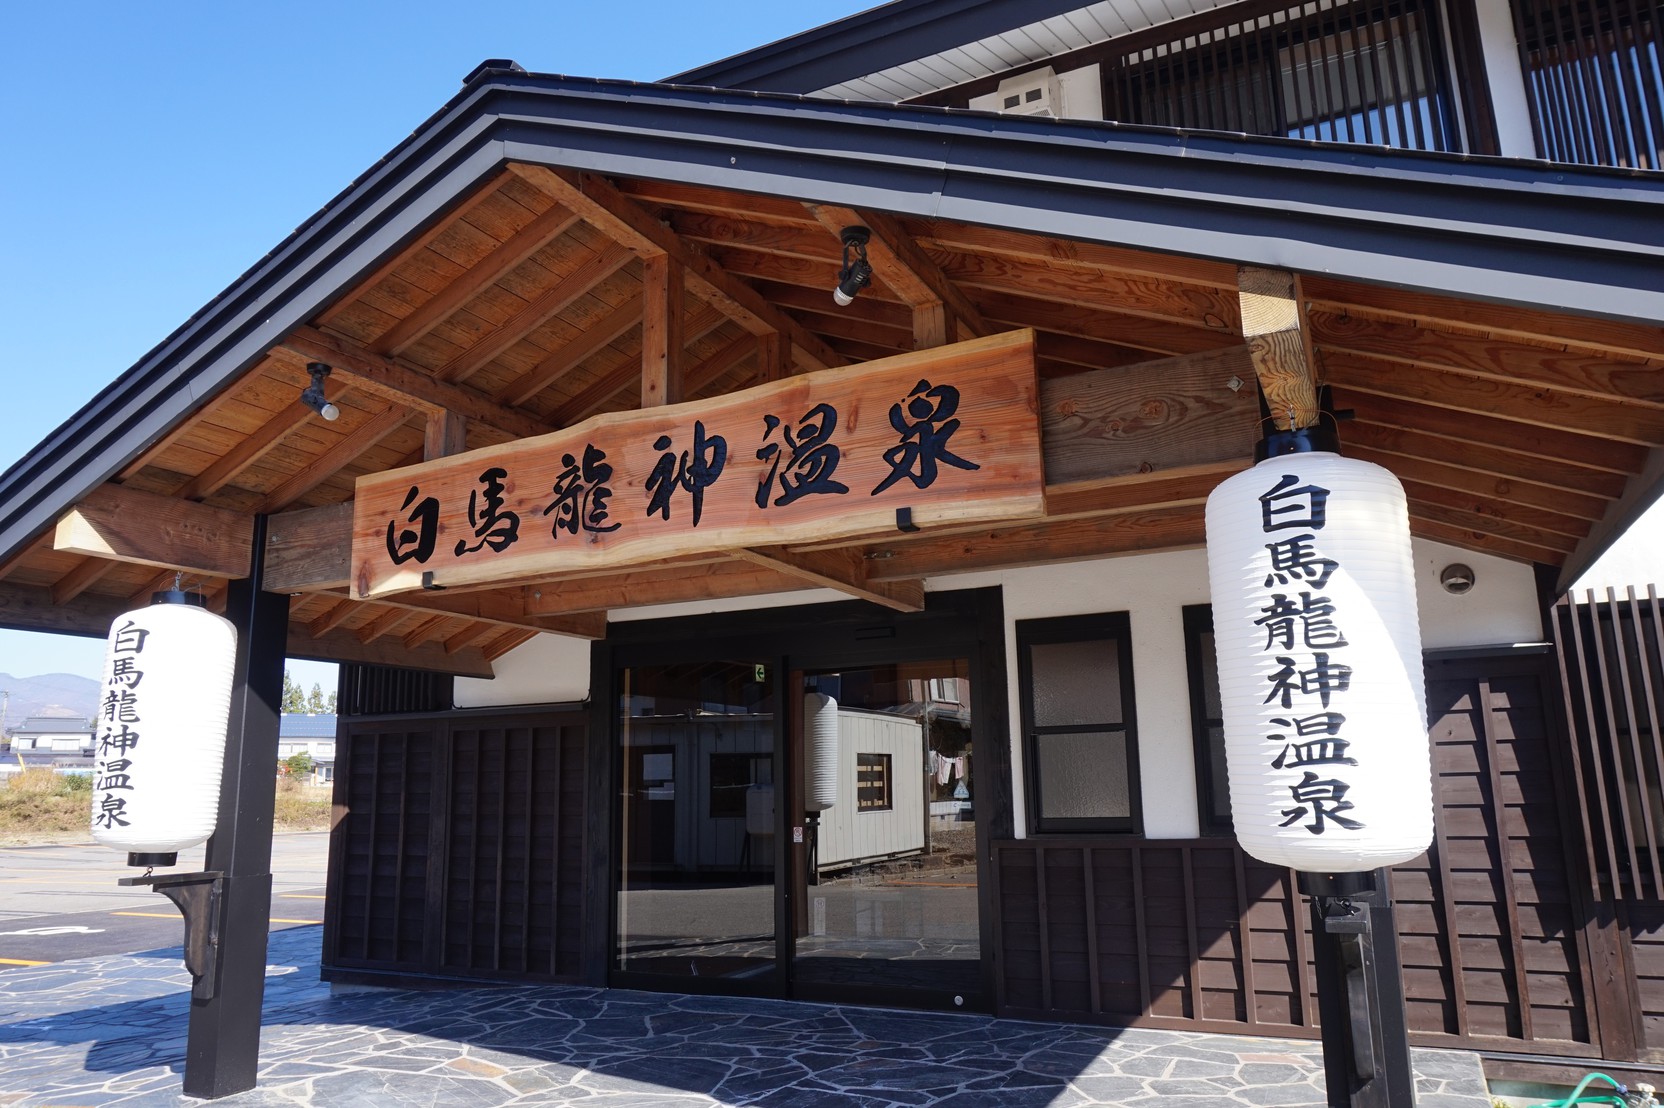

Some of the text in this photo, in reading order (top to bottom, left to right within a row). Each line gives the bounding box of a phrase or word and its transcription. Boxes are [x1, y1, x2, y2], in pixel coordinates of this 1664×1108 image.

[386, 379, 980, 565] 白馬龍神温泉
[95, 621, 150, 829] 白馬龍神温泉
[1254, 474, 1366, 835] 白馬龍神温泉
